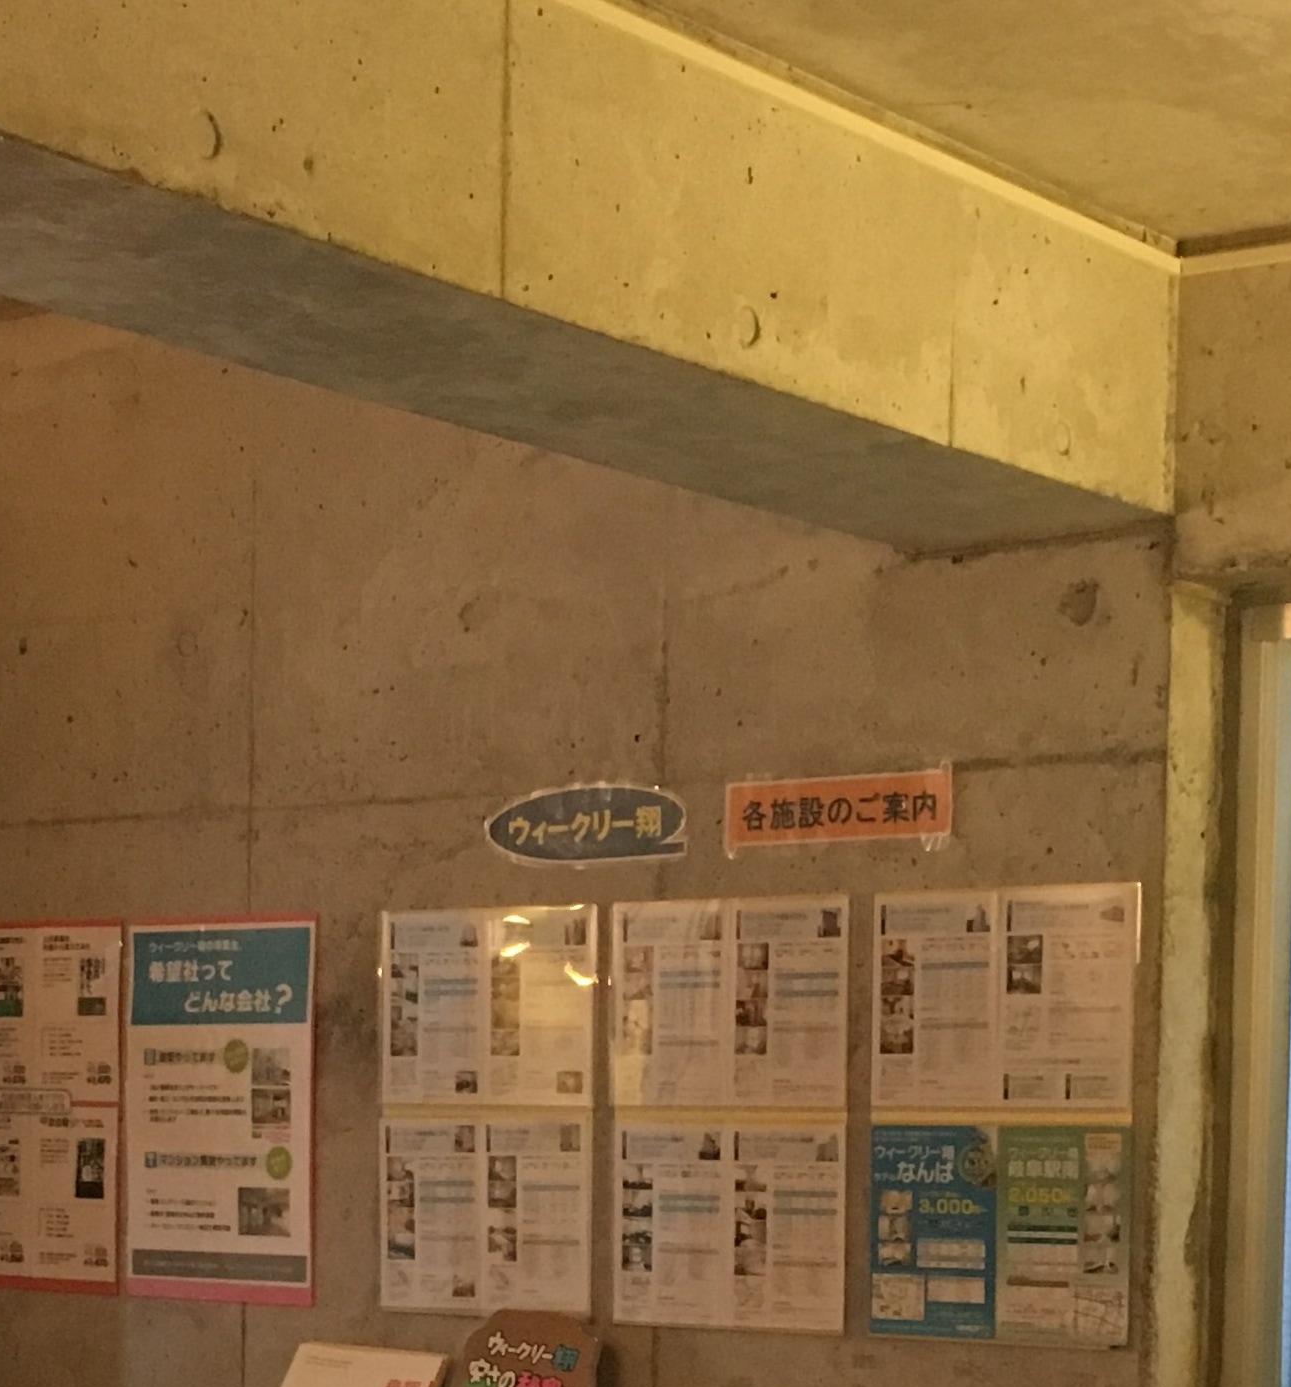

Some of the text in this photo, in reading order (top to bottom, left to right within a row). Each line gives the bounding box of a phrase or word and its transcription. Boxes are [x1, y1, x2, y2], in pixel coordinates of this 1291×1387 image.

[508, 804, 662, 847] ウィークリー翔
[742, 791, 938, 832] 各施設のご案内
[148, 958, 234, 984] 希望社って
[896, 1161, 954, 1184] なんば
